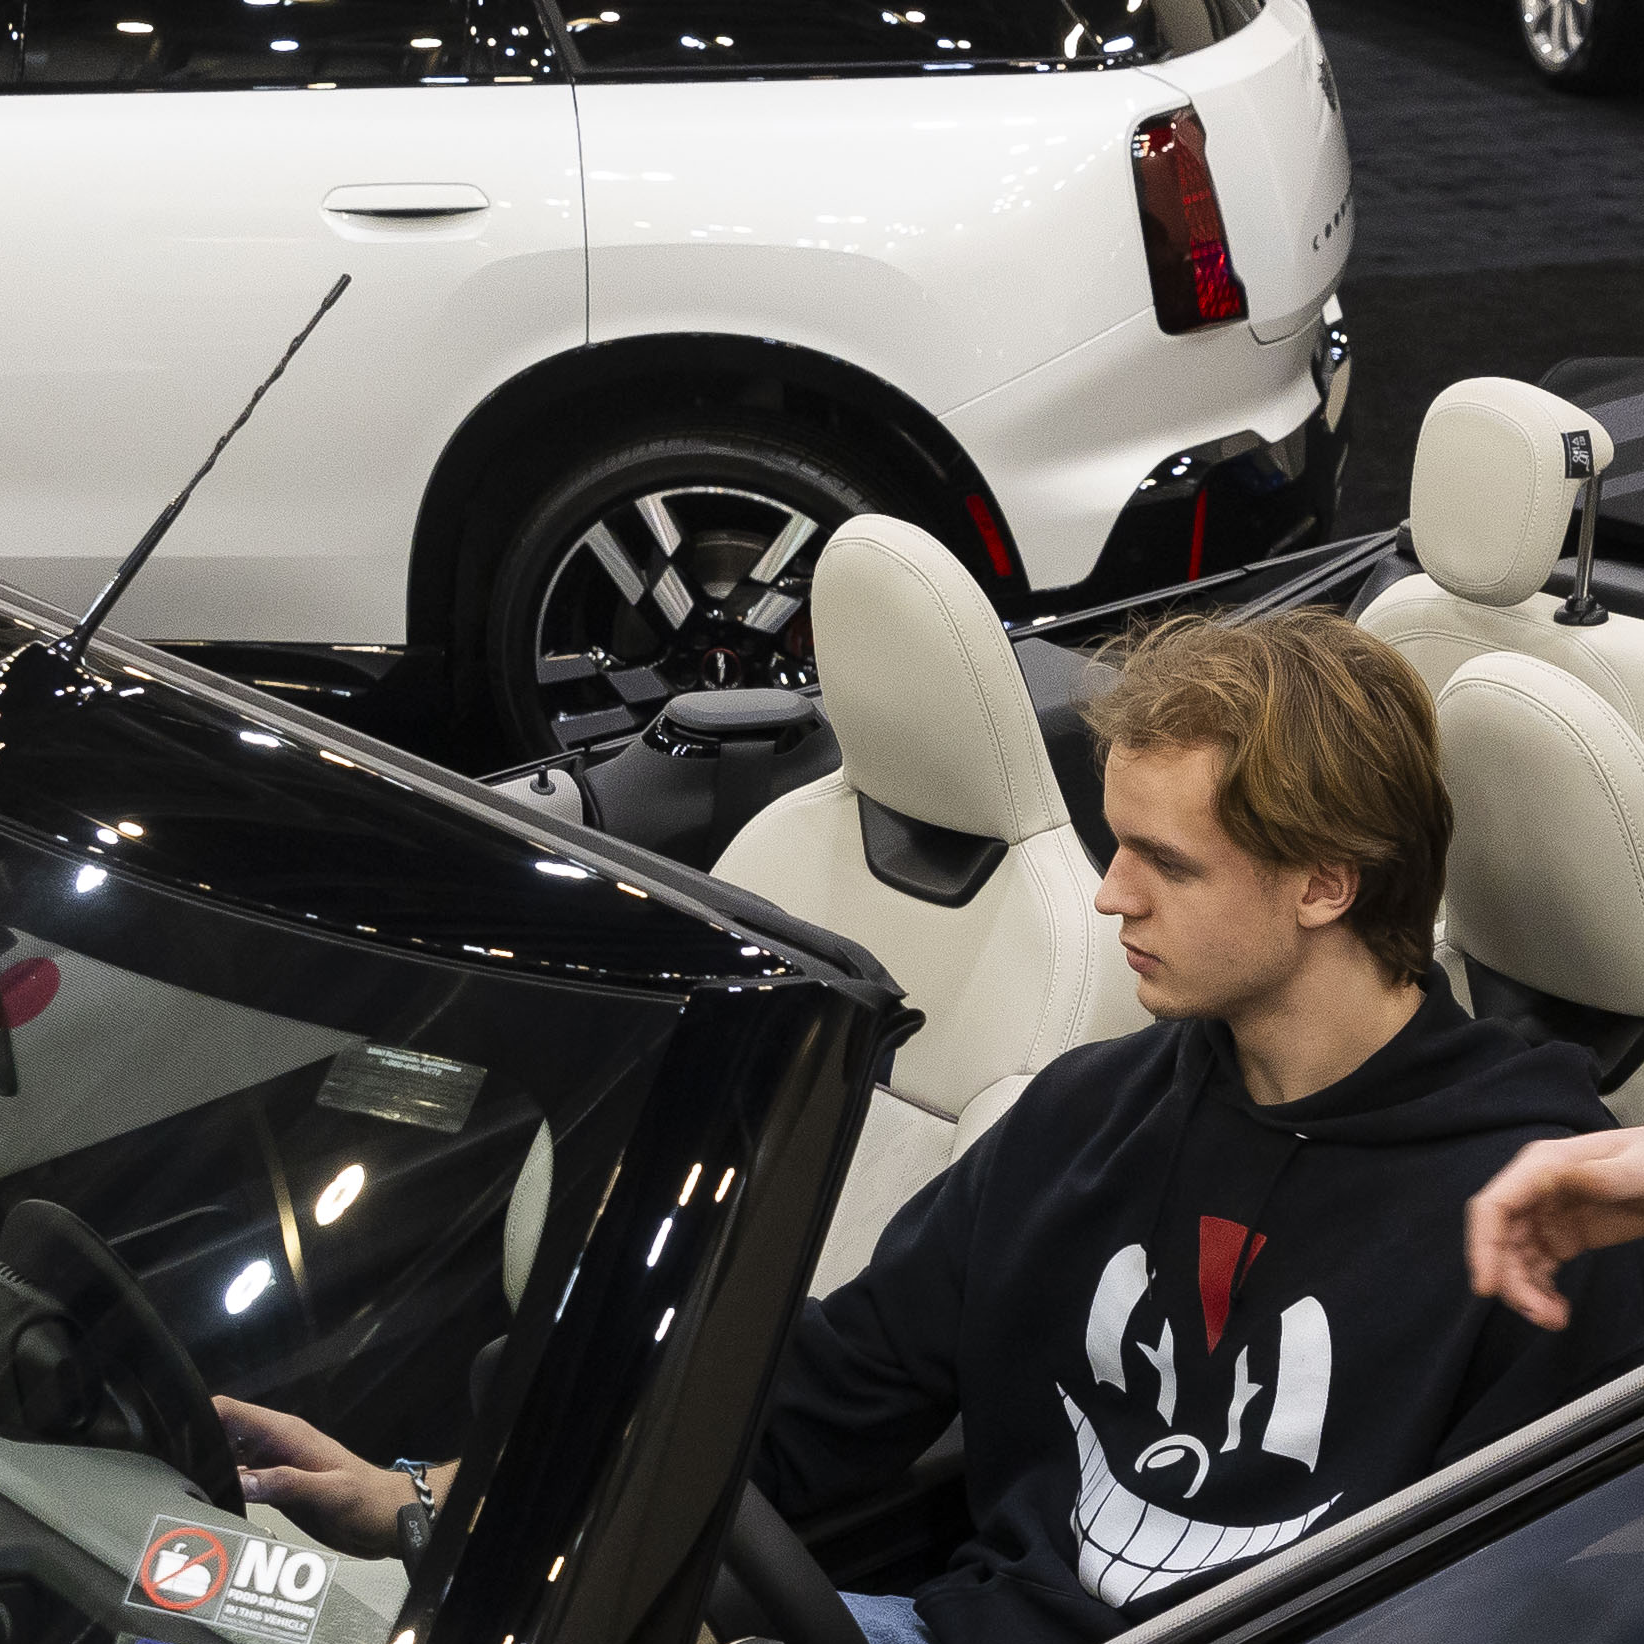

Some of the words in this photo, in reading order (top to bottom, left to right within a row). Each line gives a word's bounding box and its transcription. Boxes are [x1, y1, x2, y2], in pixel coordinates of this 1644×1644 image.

[233, 1539, 327, 1602] NO
[225, 1604, 238, 1615] IN
[237, 1607, 263, 1621] THIS
[263, 1612, 308, 1632] VEHICLE
[227, 1588, 259, 1605] FOOD
[258, 1595, 275, 1608] OR
[275, 1599, 316, 1619] DRINKS
